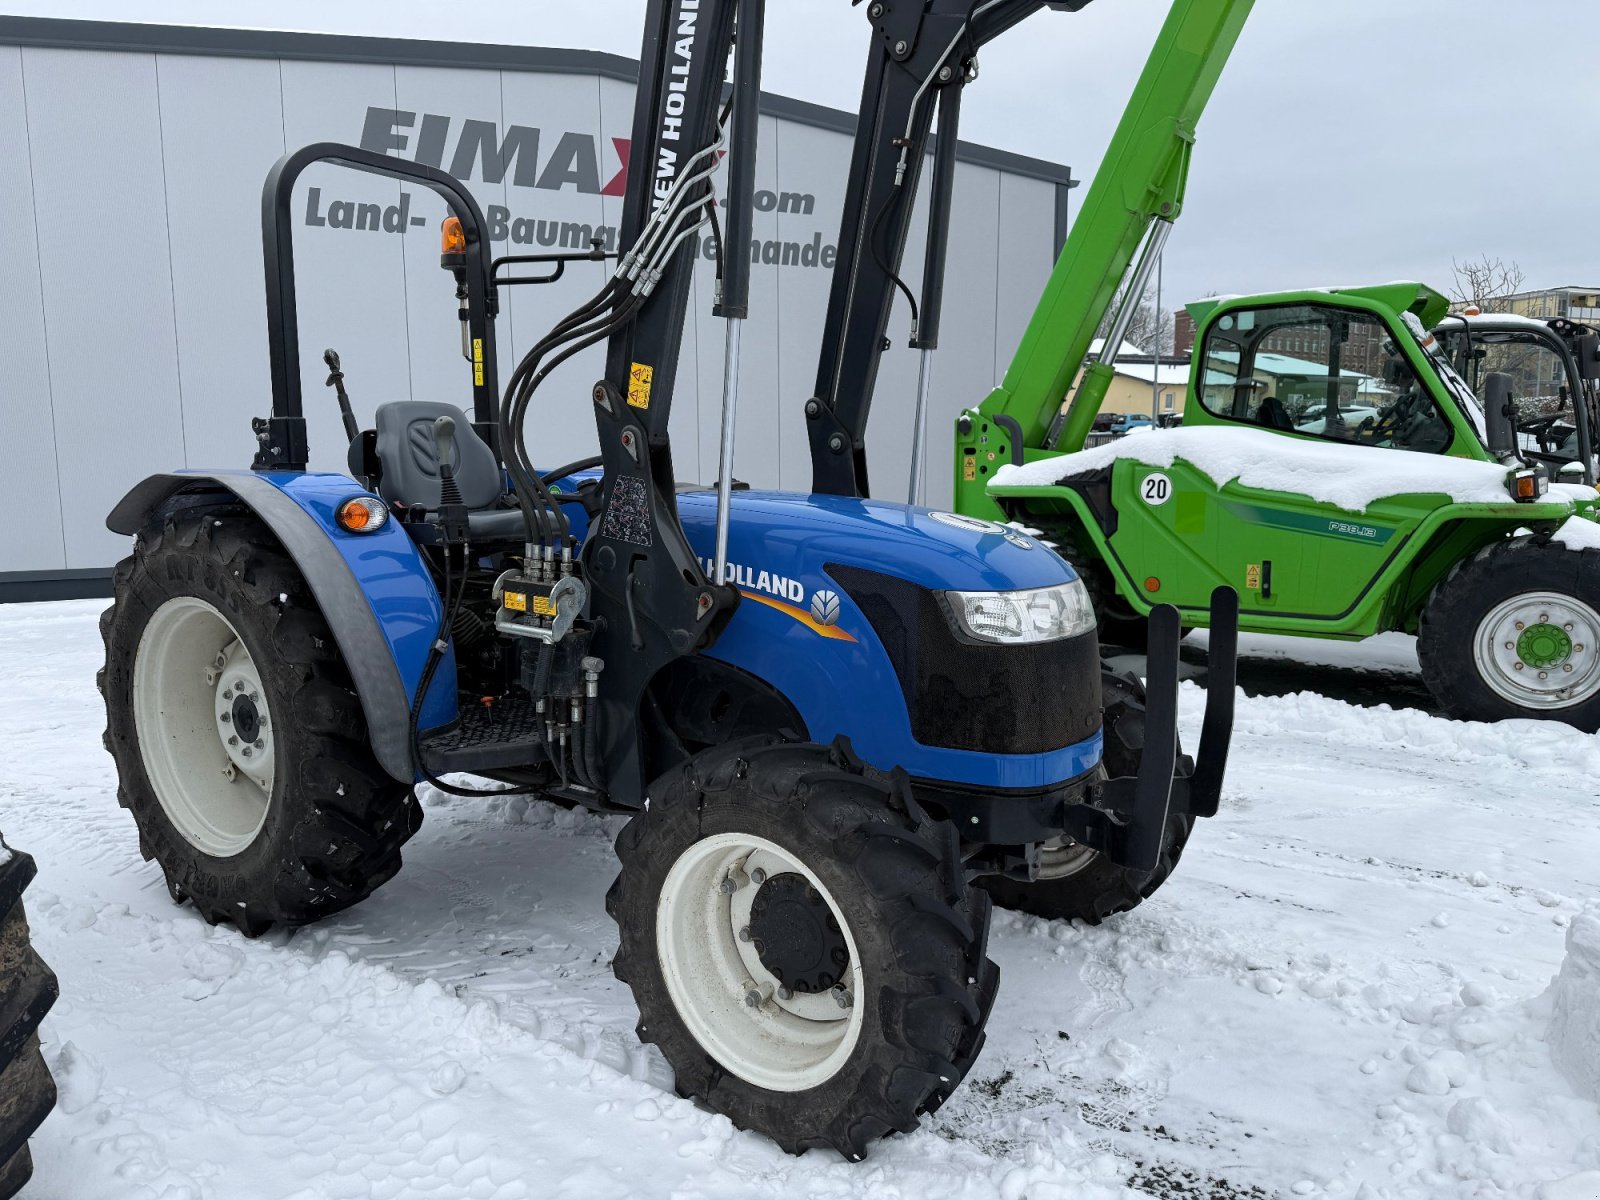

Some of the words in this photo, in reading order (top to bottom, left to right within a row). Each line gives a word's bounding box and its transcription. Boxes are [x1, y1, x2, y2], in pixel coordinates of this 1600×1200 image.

[305, 187, 427, 234] Land-
[1145, 479, 1167, 499] 20
[1328, 521, 1377, 538] P38.13
